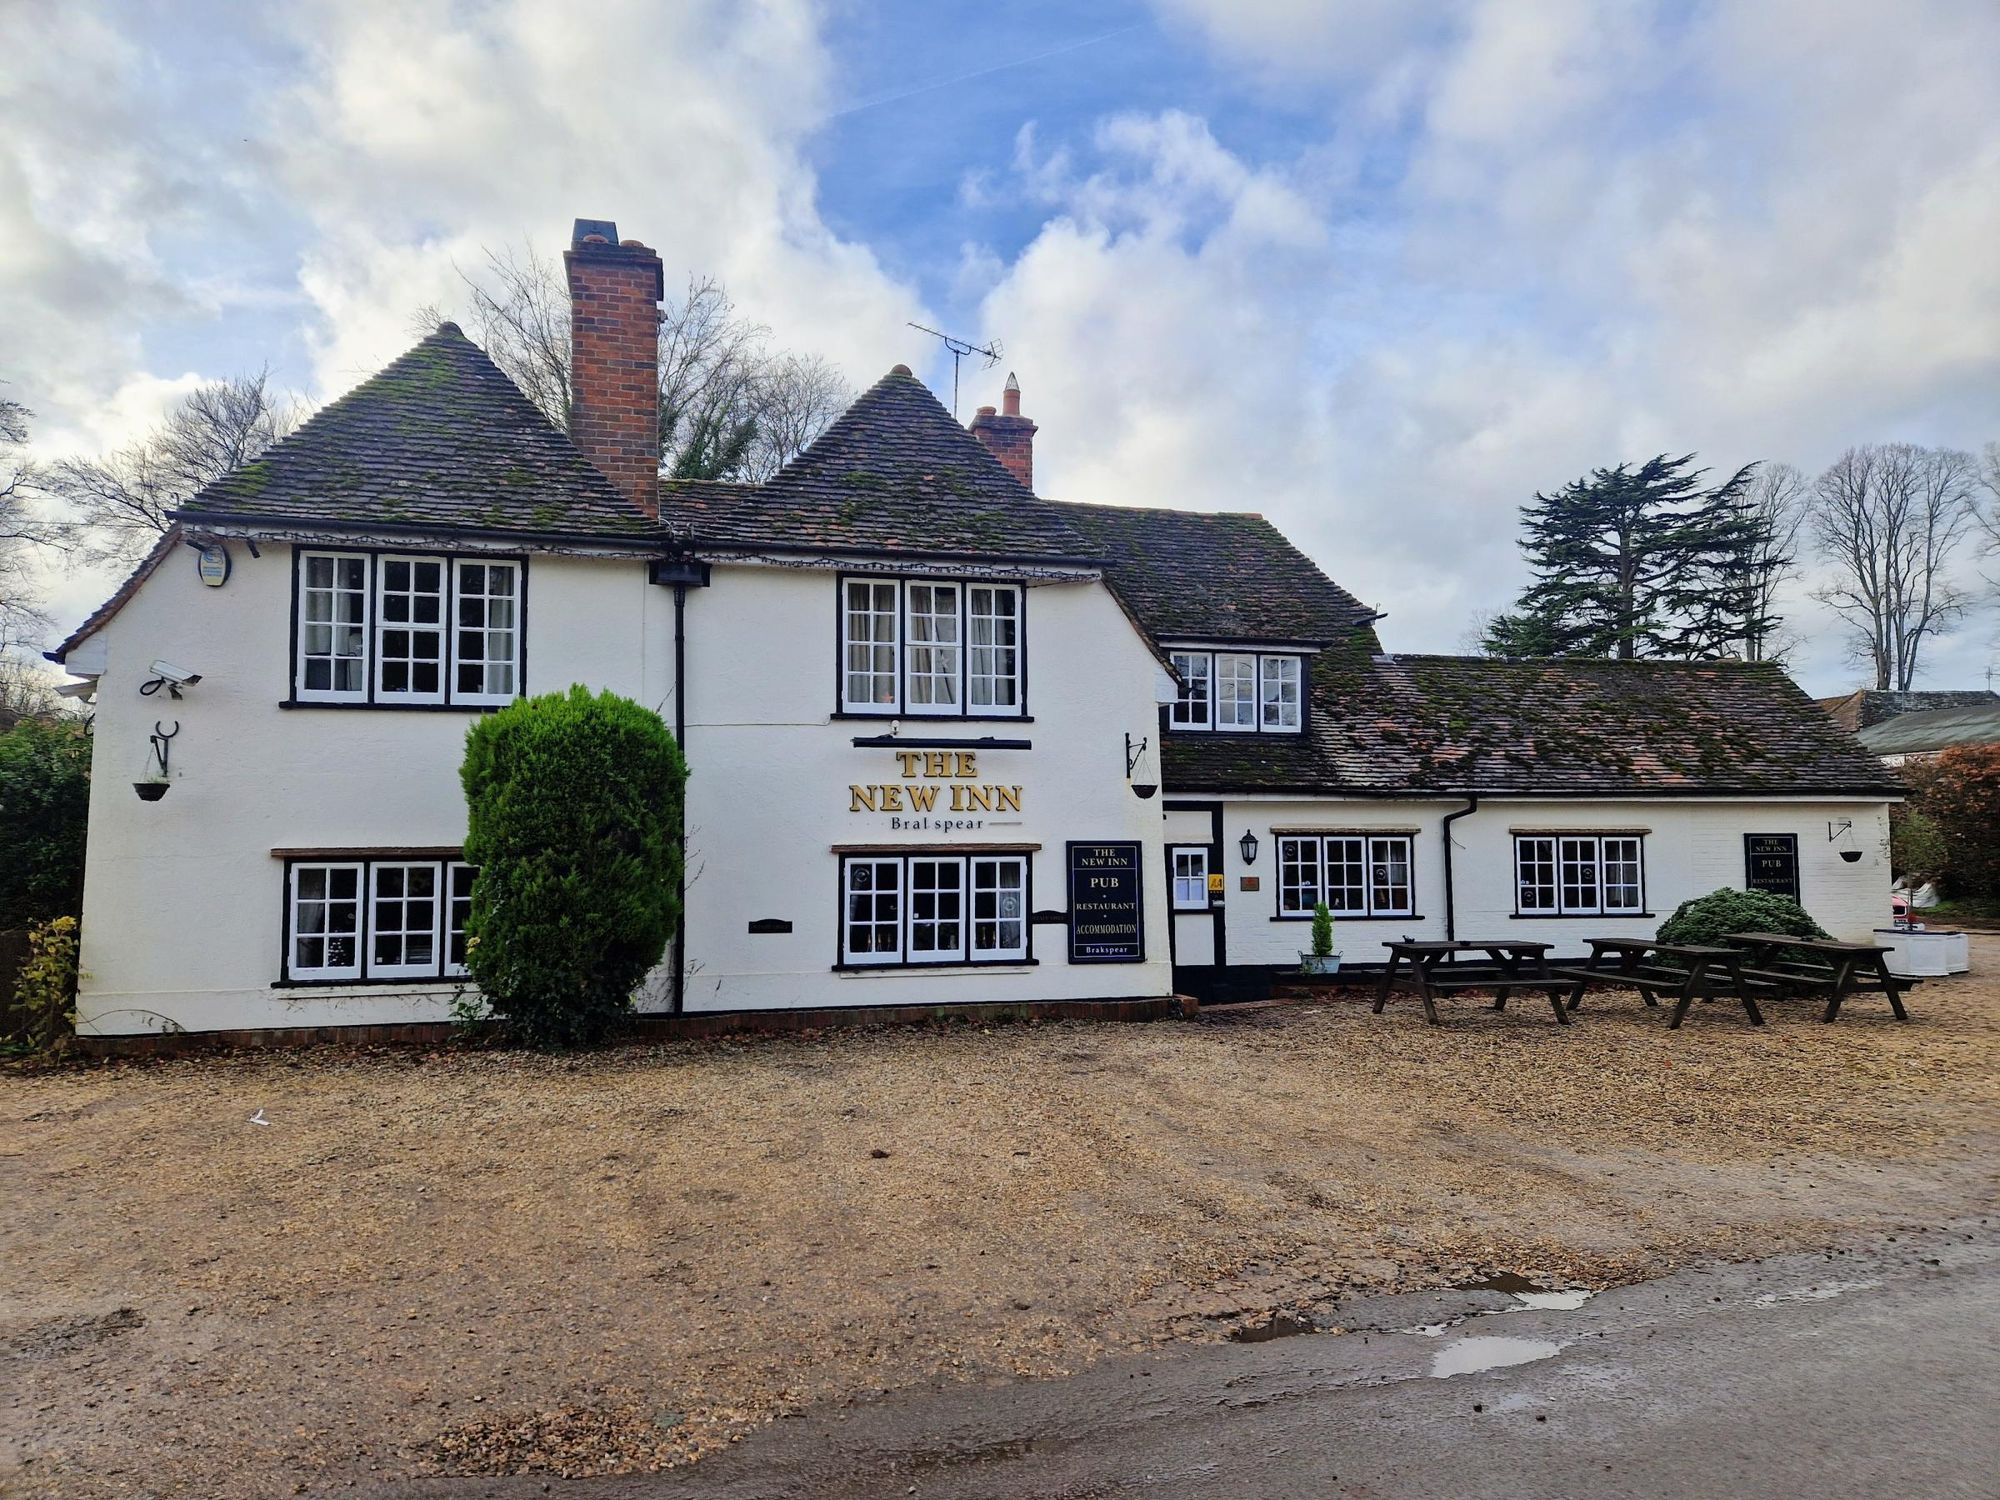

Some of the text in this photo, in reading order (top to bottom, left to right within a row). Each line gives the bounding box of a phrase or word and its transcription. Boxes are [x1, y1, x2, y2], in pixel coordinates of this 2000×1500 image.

[896, 752, 977, 778] THE
[849, 785, 1023, 811] NEW INN
[1093, 849, 1116, 857] THE
[1081, 858, 1128, 866] NEW INN
[1761, 860, 1782, 868] PUB
[1090, 877, 1119, 888] PUB
[1076, 902, 1136, 910] RESTAURANT
[1076, 924, 1137, 935] ACCOMMODATION
[1086, 946, 1128, 955] Brakspear
